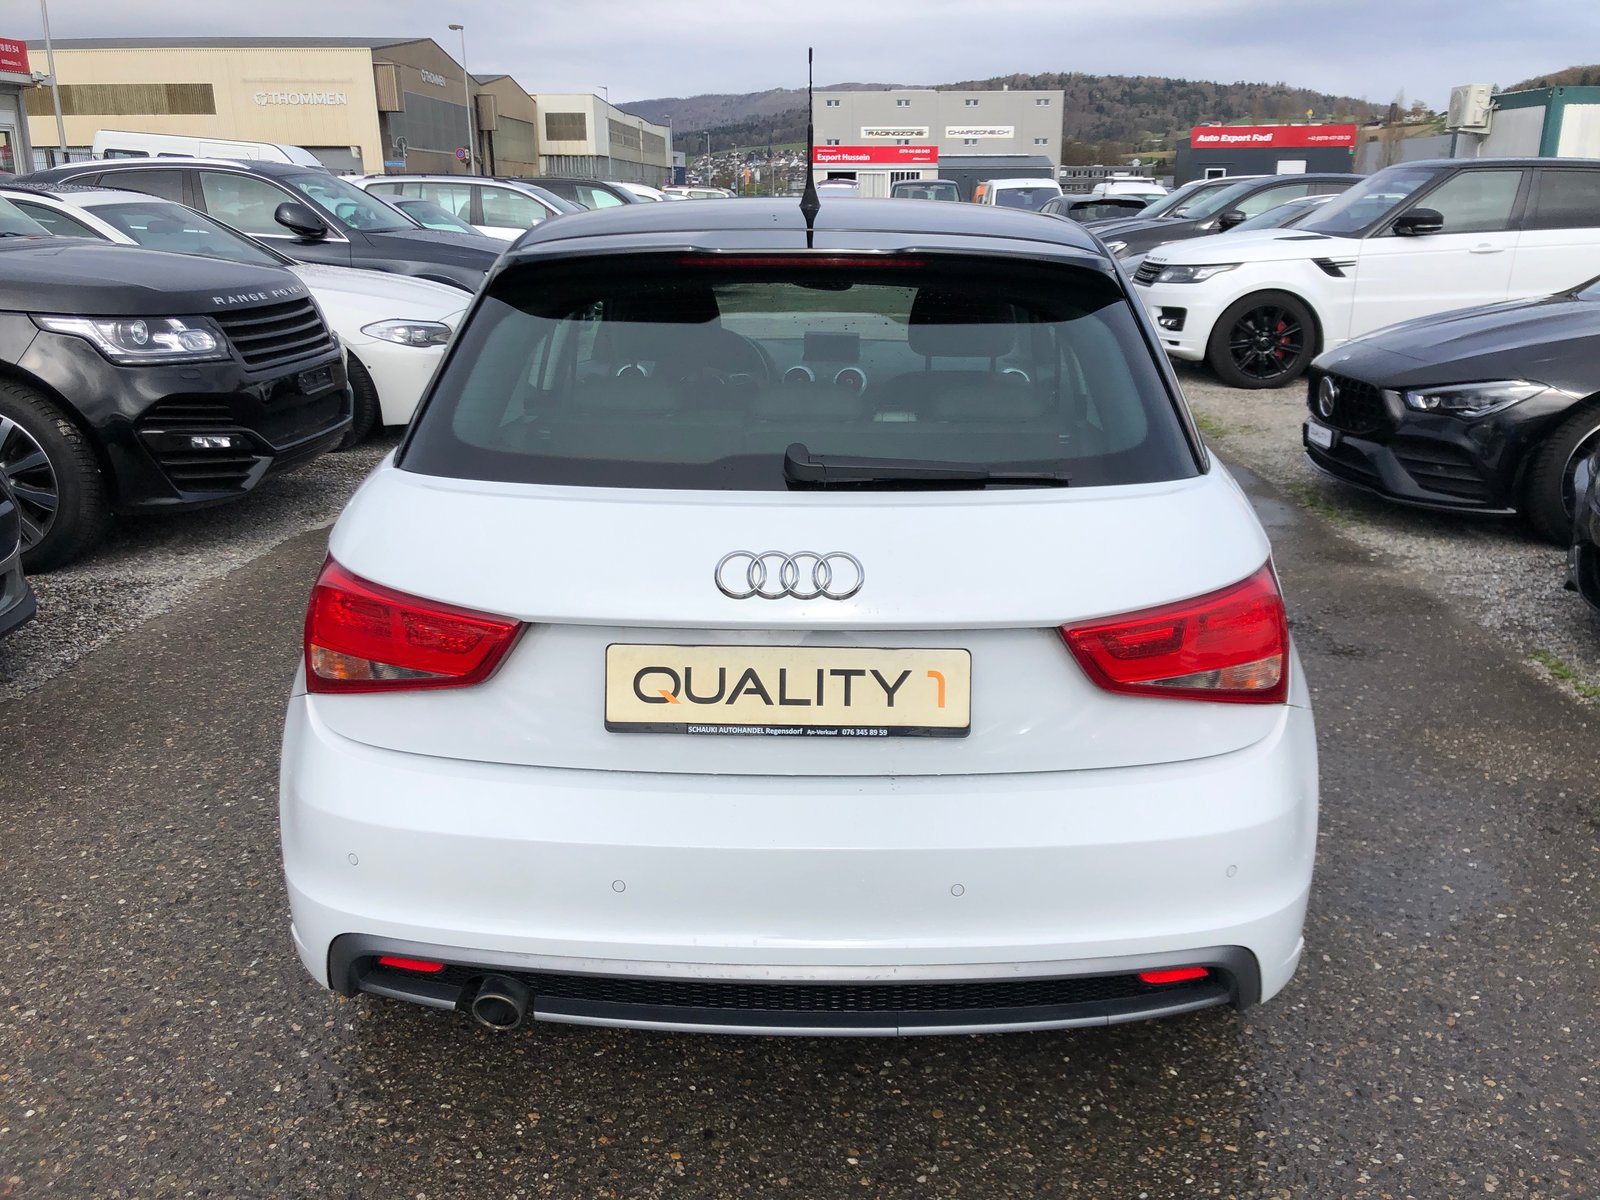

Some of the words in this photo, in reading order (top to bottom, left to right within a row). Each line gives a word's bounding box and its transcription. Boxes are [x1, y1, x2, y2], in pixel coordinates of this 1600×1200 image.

[268, 93, 347, 105] THOMMEN
[1196, 134, 1220, 142] Auto
[1220, 134, 1252, 143] Export
[817, 154, 841, 162] Export
[212, 292, 268, 305] RANGE
[632, 666, 912, 707] QUALITY
[927, 670, 945, 708] 1
[765, 727, 803, 735] Regensdorf
